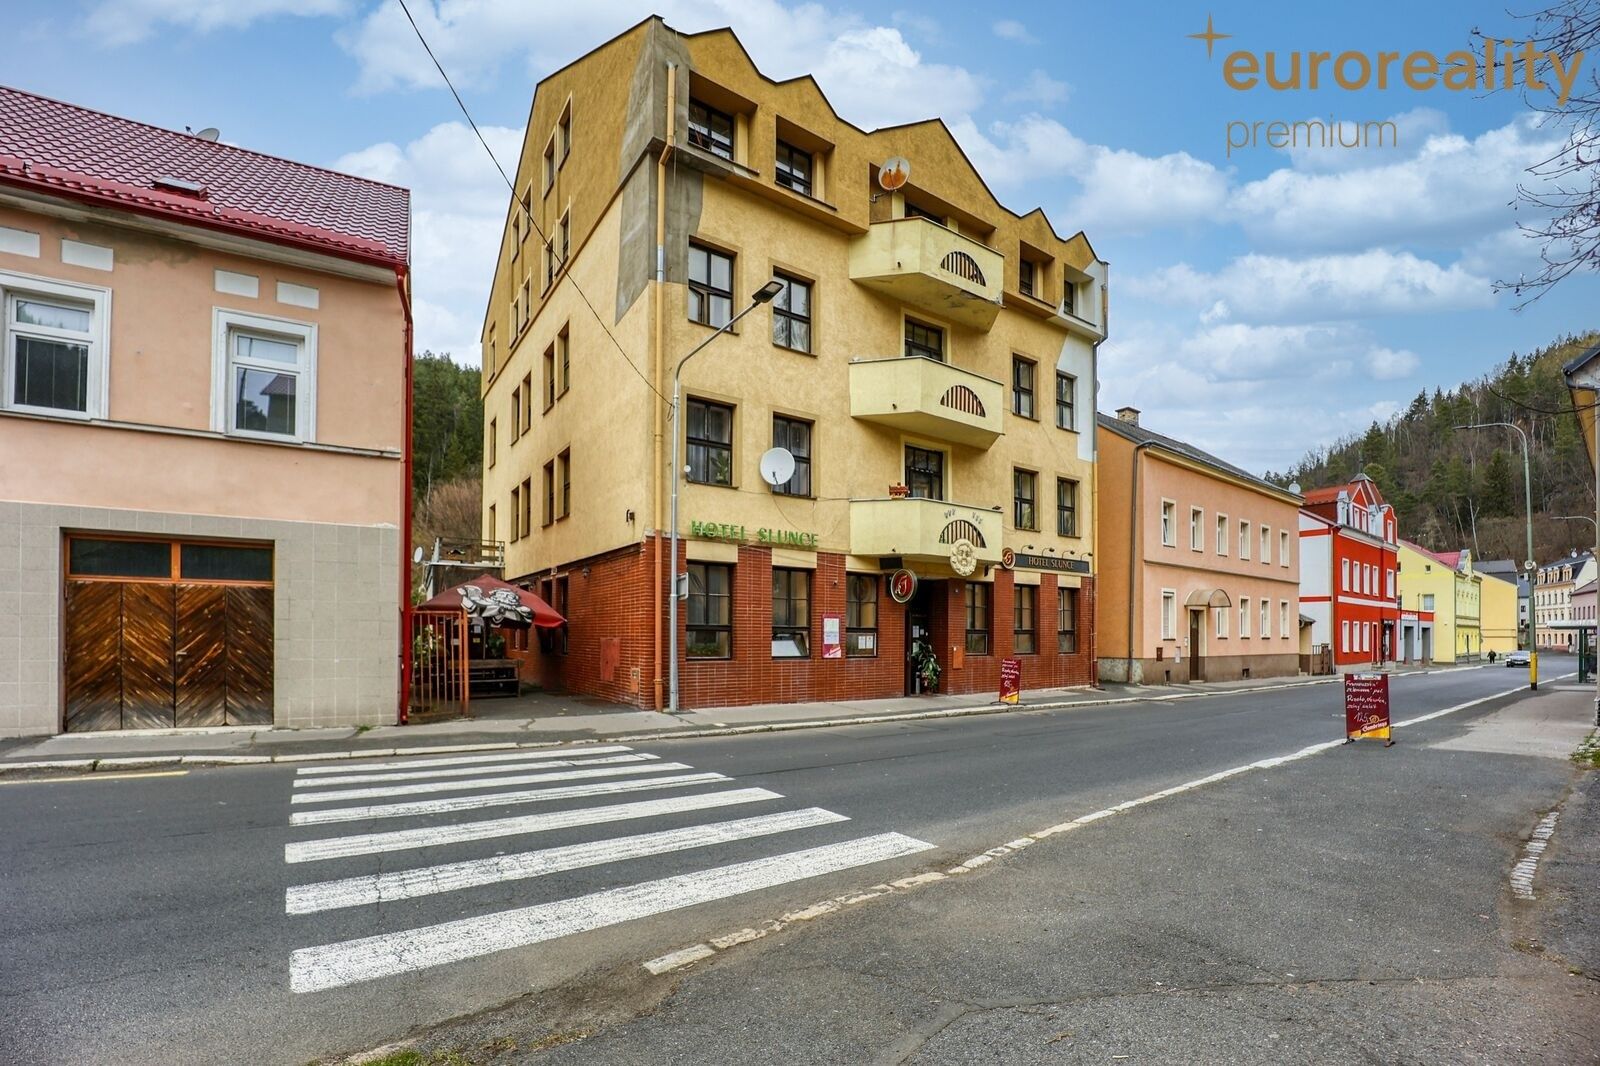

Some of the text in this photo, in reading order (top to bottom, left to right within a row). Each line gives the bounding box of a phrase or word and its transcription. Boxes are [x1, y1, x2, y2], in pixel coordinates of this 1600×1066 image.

[691, 520, 746, 540] HOTEL
[1028, 557, 1076, 570] HOTEL SLUNCE
